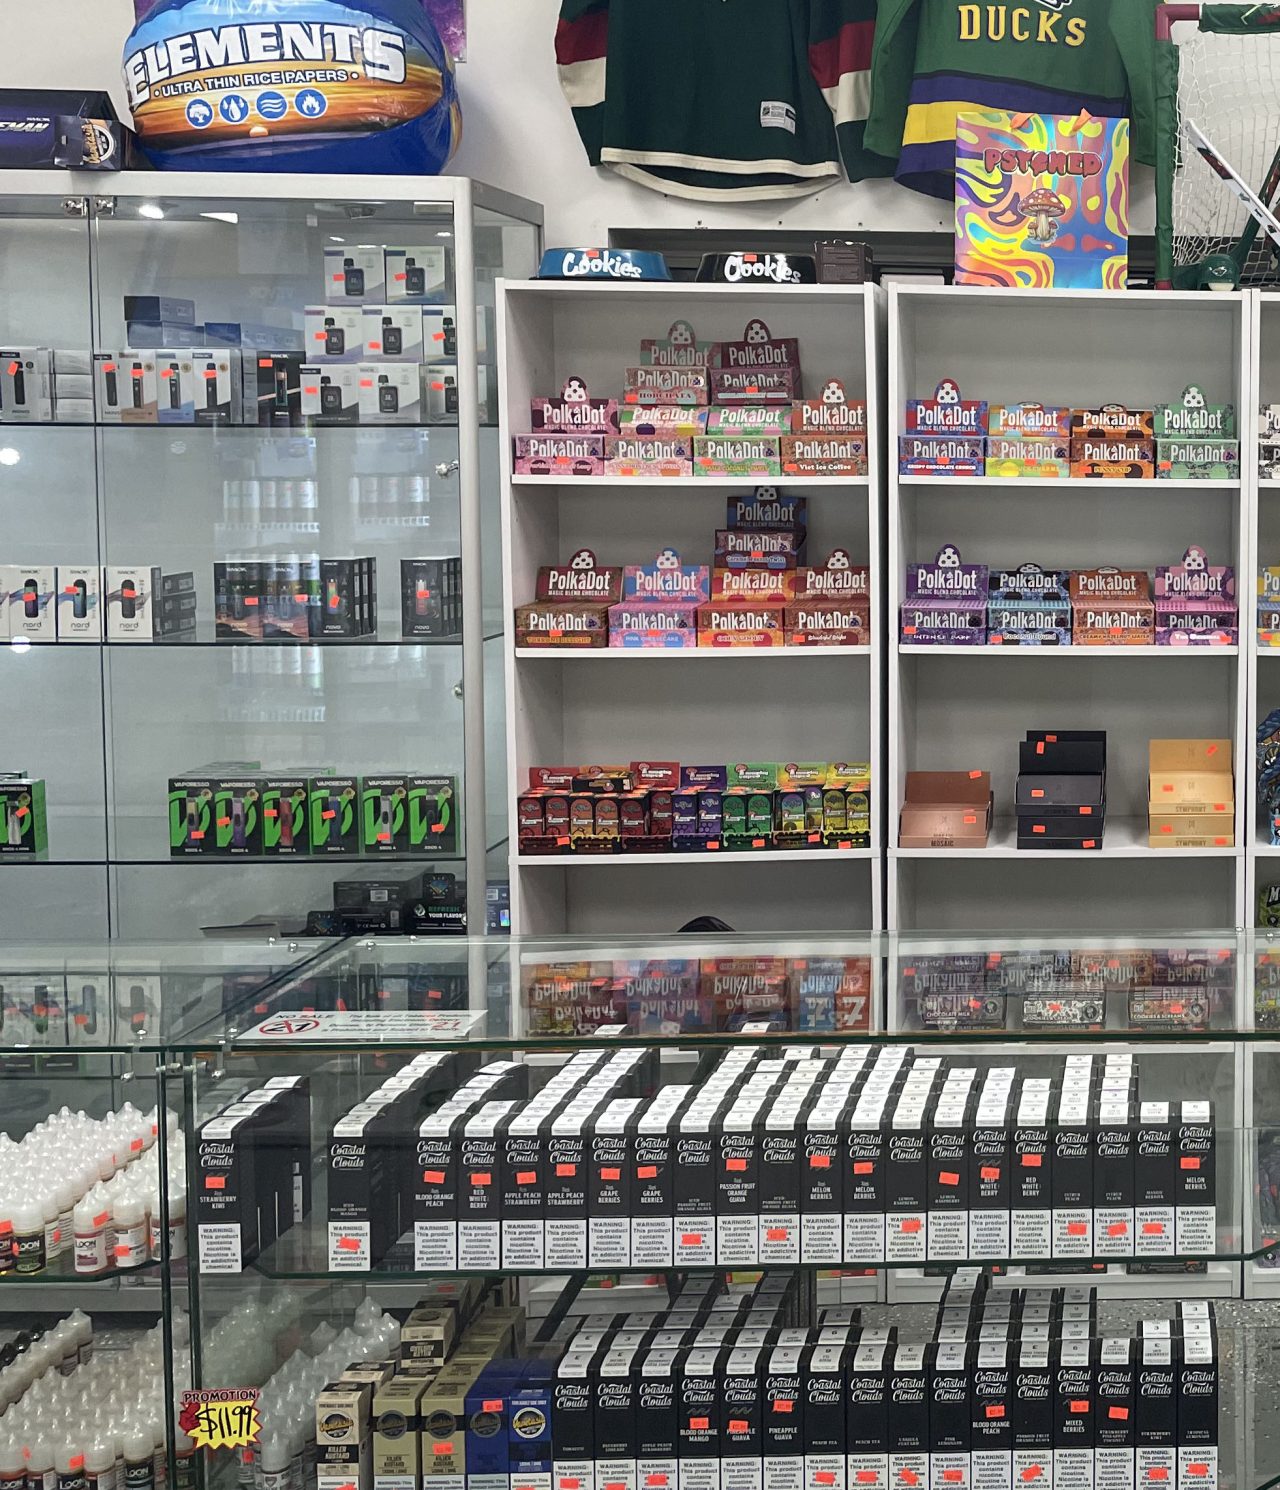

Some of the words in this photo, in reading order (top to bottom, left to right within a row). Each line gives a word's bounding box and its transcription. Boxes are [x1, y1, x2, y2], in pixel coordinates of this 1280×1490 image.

[958, 4, 1087, 47] DUCKS
[125, 22, 407, 108] ELEMENTS
[162, 81, 202, 96] ULTRA
[205, 77, 241, 91] THIN
[244, 73, 281, 88] RICE
[284, 69, 348, 84] PAPERS
[562, 250, 643, 278] Cookies
[724, 254, 801, 283] Cookies
[848, 1134, 882, 1146] Coastal
[973, 1130, 1007, 1143] Coastal
[1179, 1127, 1213, 1140] Coastal
[199, 1142, 235, 1156] Coastal
[417, 1140, 452, 1153] Coastal
[591, 1137, 627, 1150] Coastal
[974, 1142, 1006, 1155] Clouds
[1180, 1139, 1211, 1152] Clouds
[593, 1149, 626, 1162] Clouds
[849, 1146, 881, 1158] Clouds
[200, 1155, 233, 1168] Clouds
[418, 1152, 451, 1166] Clouds
[76, 1239, 97, 1248] LOON
[1057, 1369, 1091, 1382] Coastal
[1181, 1371, 1215, 1384] Coastal
[597, 1383, 632, 1396] Coastal
[850, 1378, 884, 1390] Coastal
[1059, 1381, 1090, 1394] Clouds
[1183, 1383, 1214, 1396] Clouds
[184, 1388, 258, 1403] PROMOTION
[599, 1395, 630, 1408] Clouds
[851, 1390, 883, 1403] Clouds
[200, 1403, 254, 1442] $11.99
[126, 1466, 149, 1477] LOON
